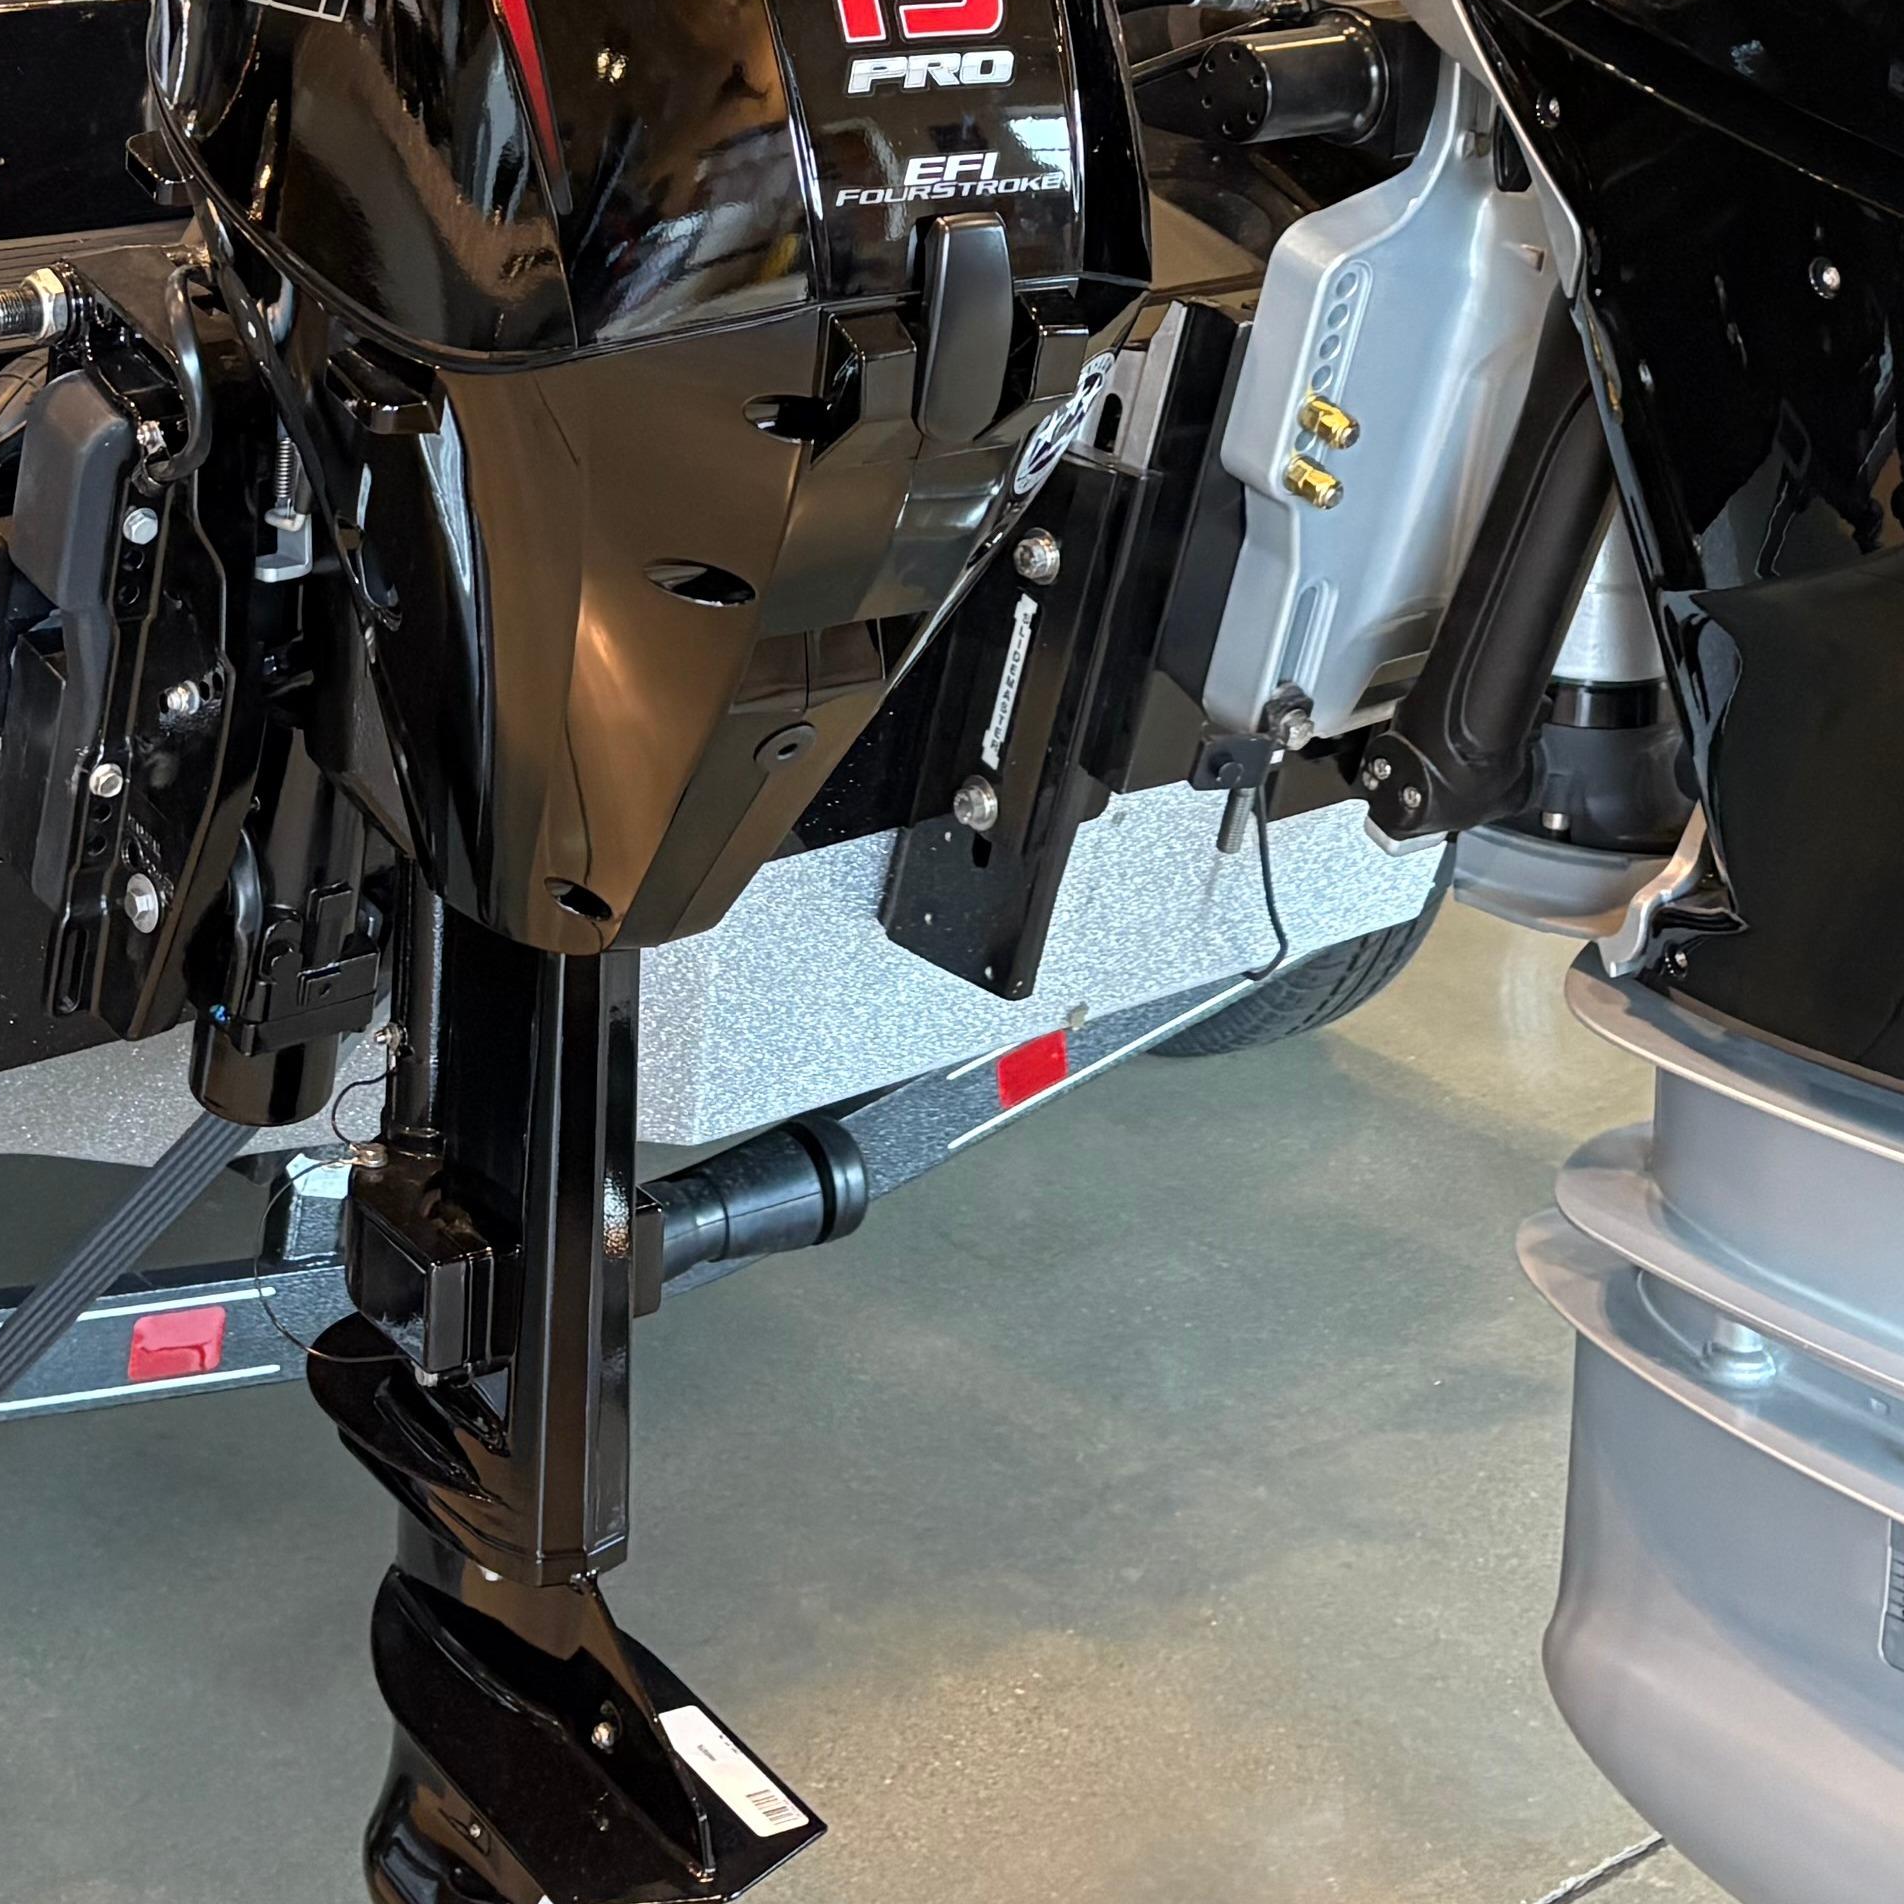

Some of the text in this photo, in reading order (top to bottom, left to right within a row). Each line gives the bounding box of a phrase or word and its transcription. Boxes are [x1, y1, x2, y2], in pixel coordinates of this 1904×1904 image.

[847, 49, 1015, 94] PRO
[903, 151, 1000, 186] EFI
[835, 171, 1068, 207] FOURSTROKE
[989, 612, 1031, 753] SLIDEMASTER
